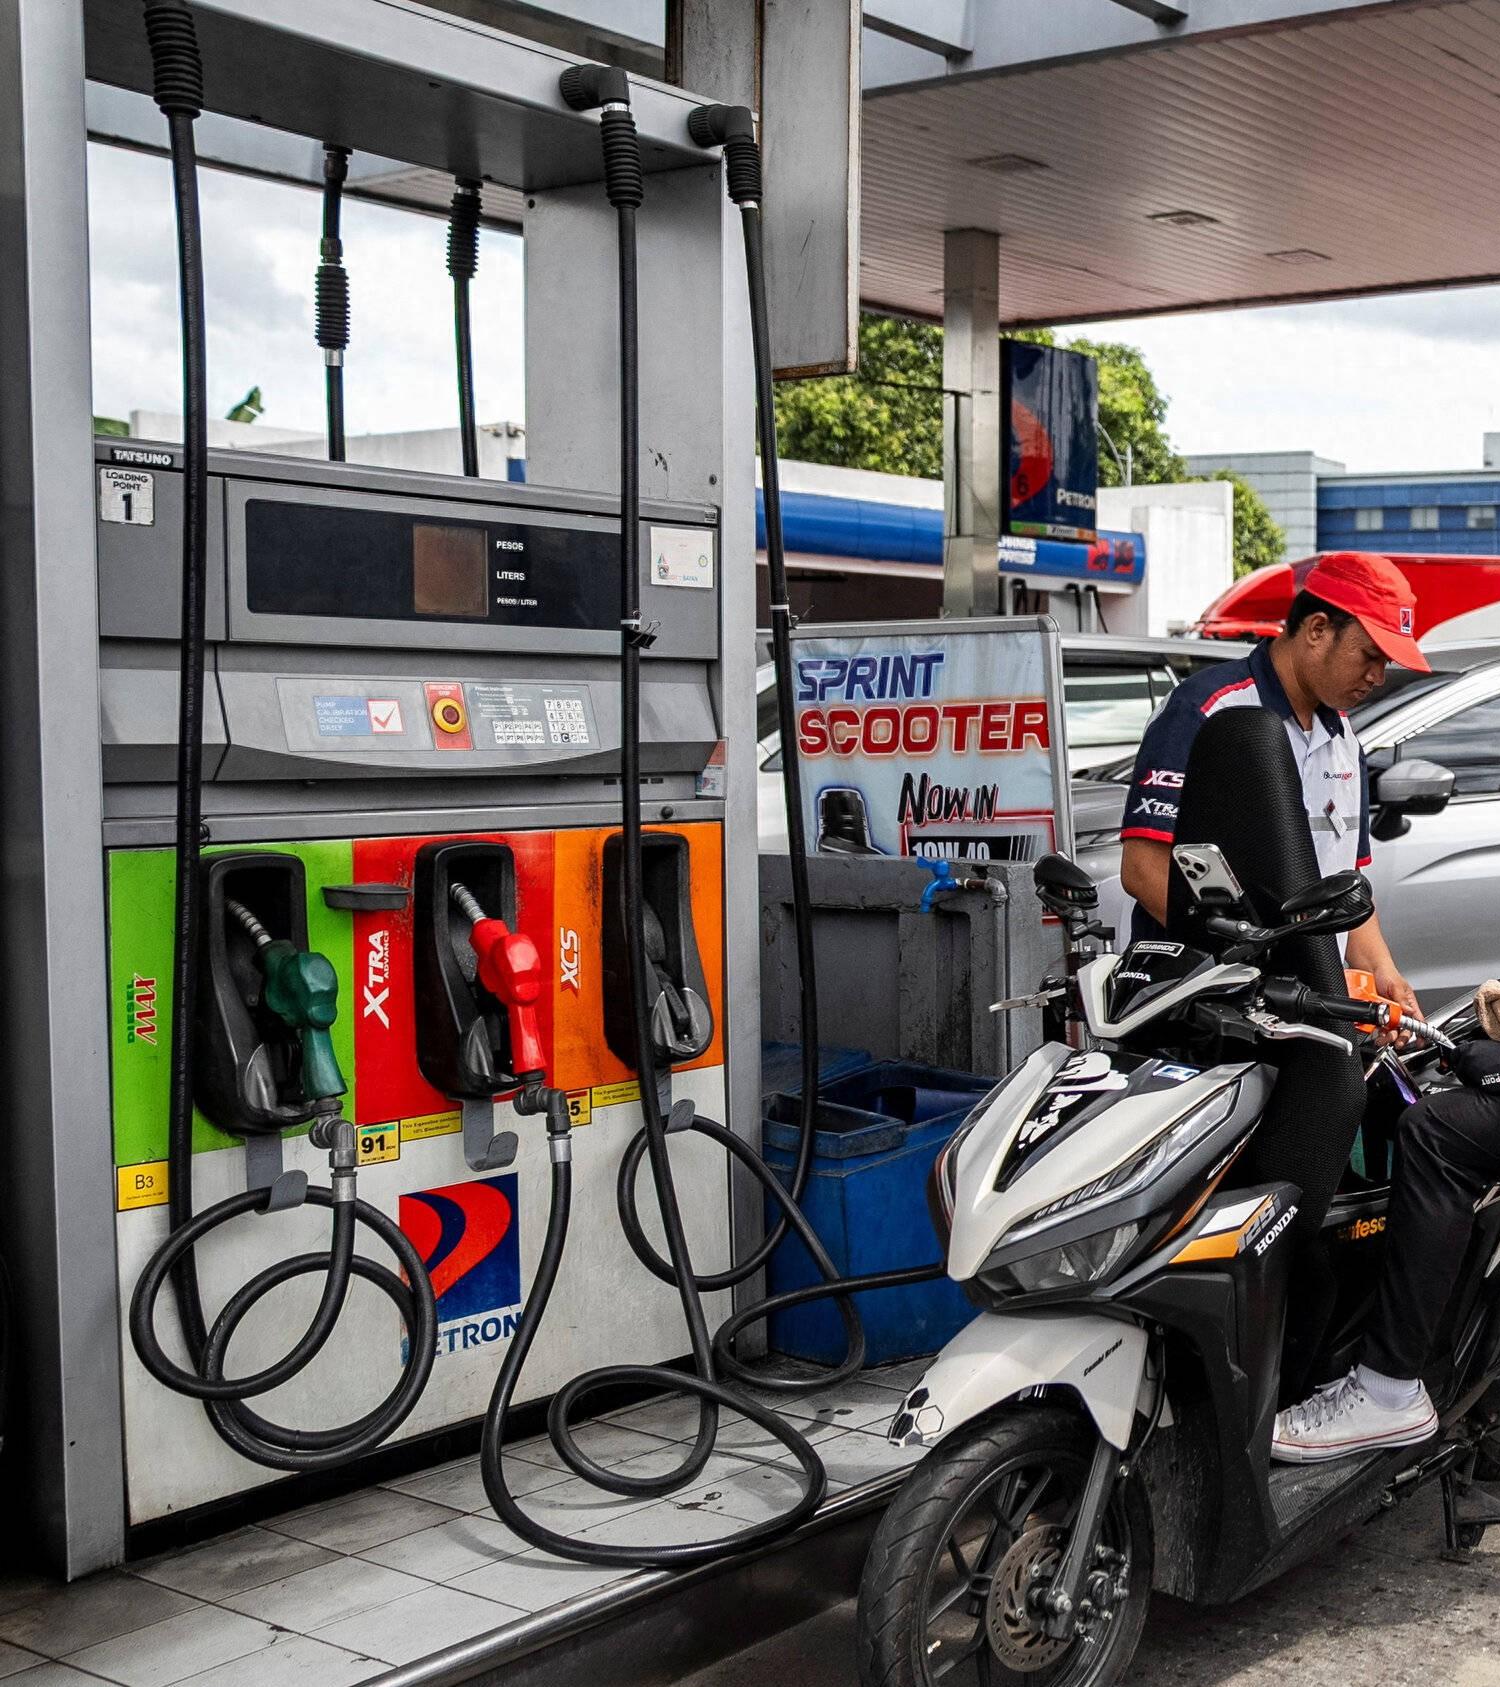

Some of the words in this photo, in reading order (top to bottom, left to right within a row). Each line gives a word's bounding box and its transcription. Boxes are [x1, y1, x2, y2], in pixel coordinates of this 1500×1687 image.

[113, 449, 172, 465] TATSUNO
[106, 471, 148, 483] LOADING
[113, 481, 141, 491] POINT
[122, 493, 132, 520] 1
[496, 540, 524, 551] PESOS
[496, 570, 525, 581] LITERS
[797, 652, 945, 702] SPRINT
[798, 701, 1051, 756] SCOOTER
[1140, 769, 1186, 788] XCS
[972, 782, 1000, 824] IN
[560, 927, 579, 991] XCS
[363, 930, 390, 1030] XTRA
[1117, 971, 1151, 982] HONDA
[126, 979, 135, 1044] DIESEL
[361, 1134, 386, 1154] 91
[135, 1174, 154, 1190] B3
[1254, 1205, 1299, 1257] HONDA
[400, 1311, 522, 1368] TRON
